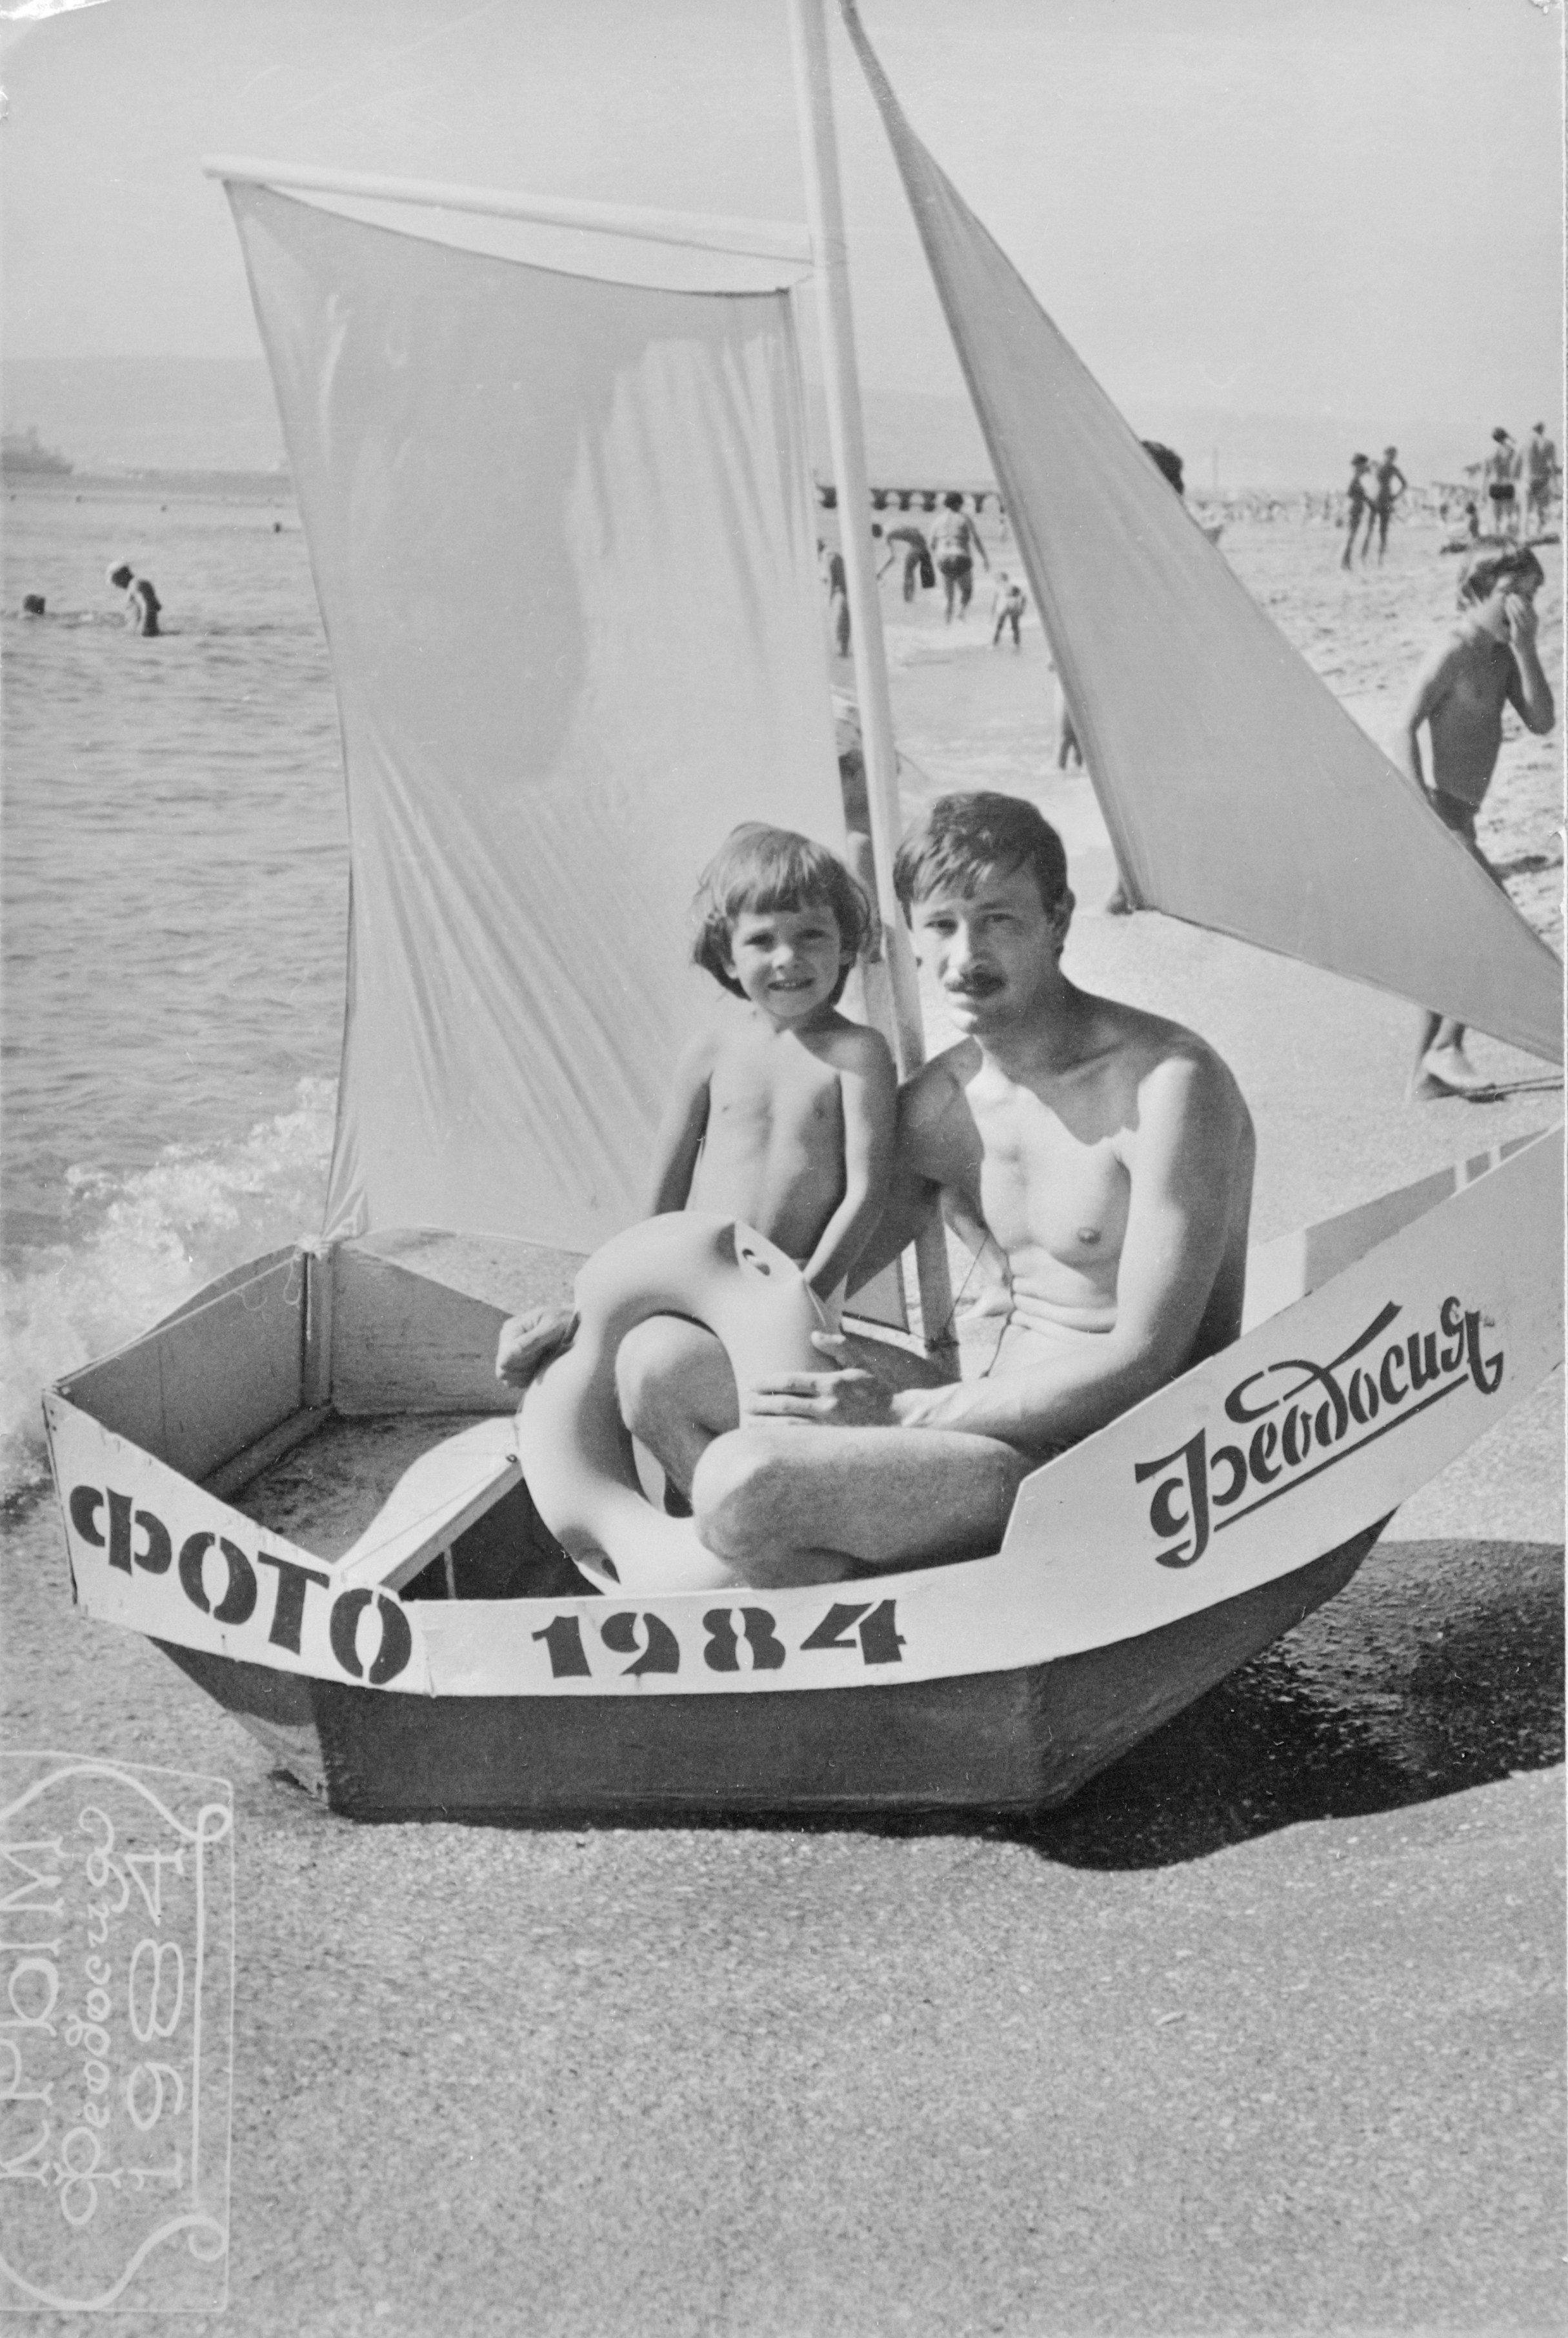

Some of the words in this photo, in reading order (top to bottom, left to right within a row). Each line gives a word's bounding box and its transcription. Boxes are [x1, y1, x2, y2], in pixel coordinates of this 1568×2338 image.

[1134, 1295, 1504, 1569] Феодосия
[68, 1485, 412, 1686] ФОТО
[531, 1598, 907, 1679] 1984
